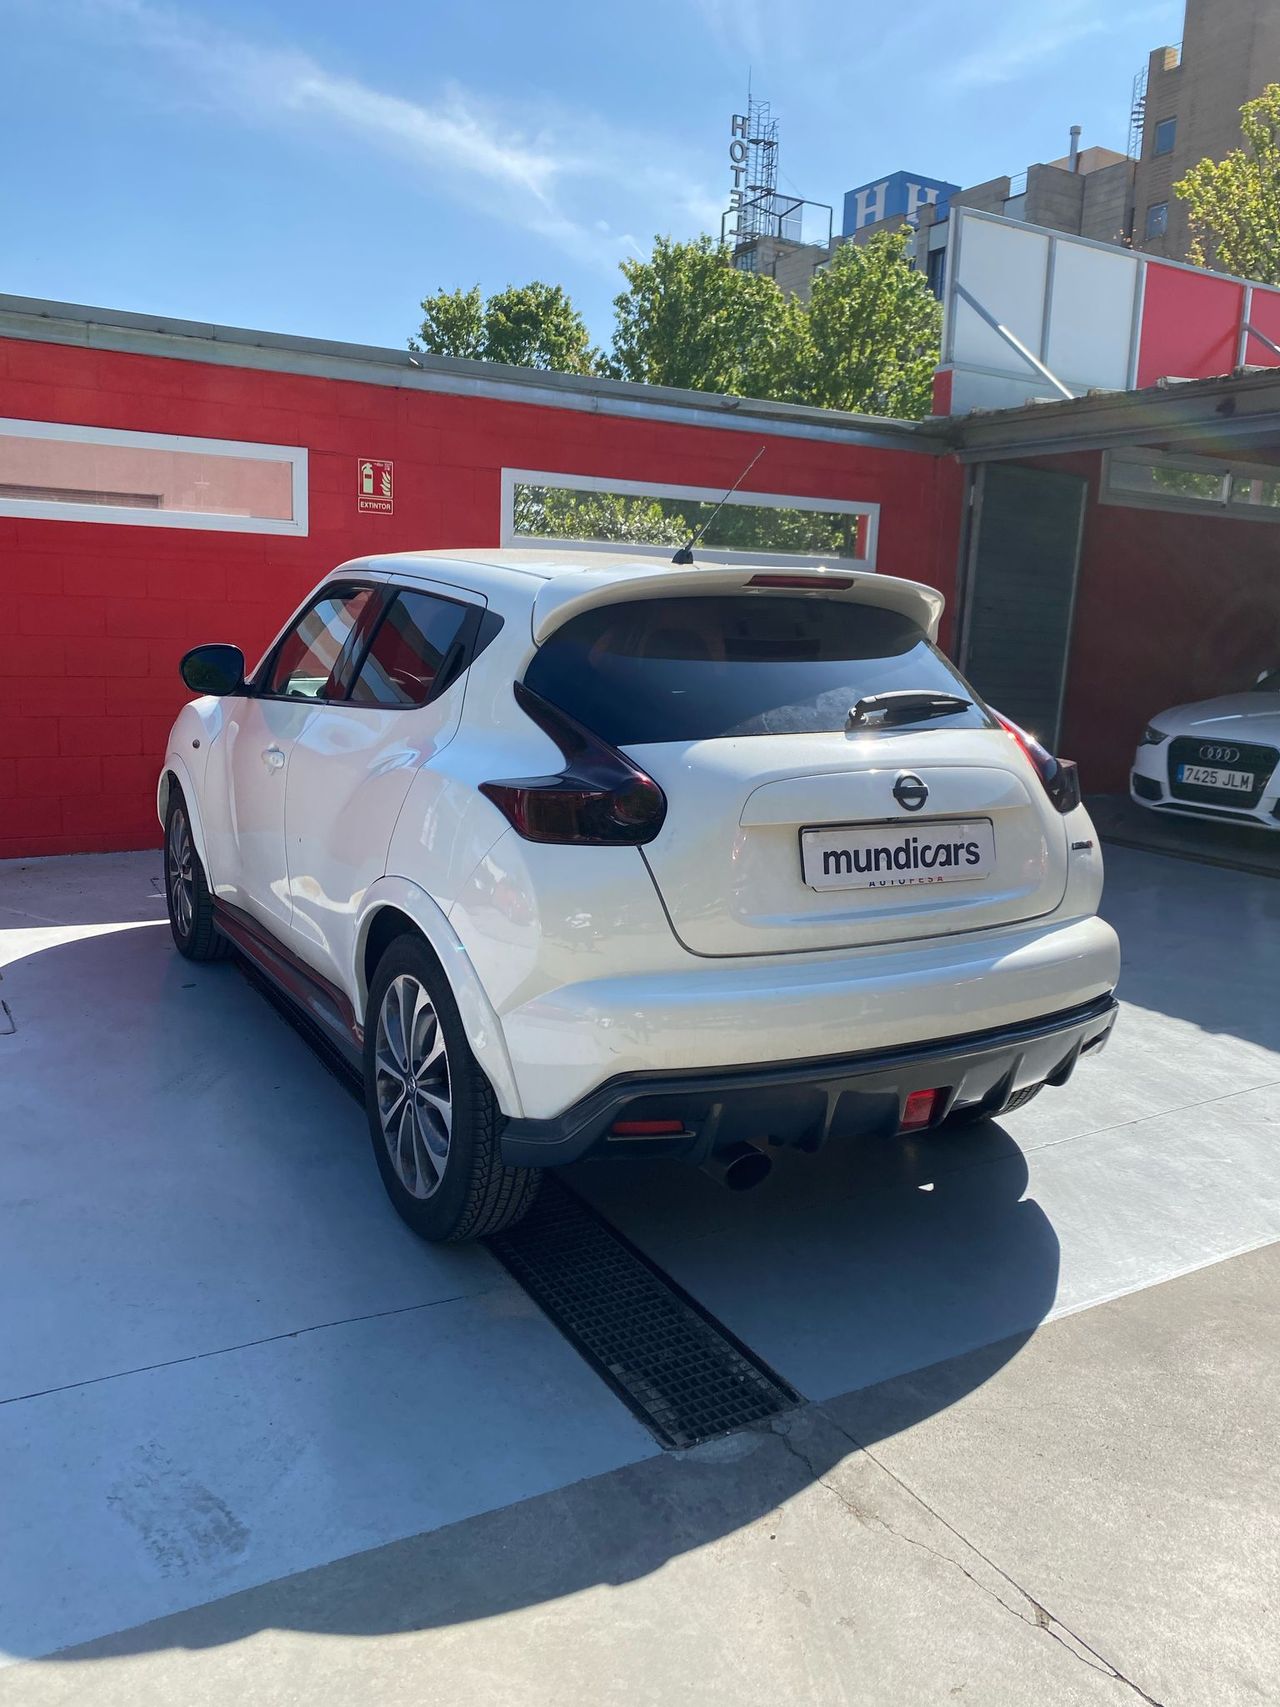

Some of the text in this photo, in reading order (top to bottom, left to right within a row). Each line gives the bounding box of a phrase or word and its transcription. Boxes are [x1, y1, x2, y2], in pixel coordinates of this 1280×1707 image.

[855, 181, 889, 230] H
[906, 182, 940, 224] H
[360, 501, 391, 511] EXTINTOR
[1186, 767, 1250, 790] 7425 JLM
[823, 837, 981, 875] mundicars
